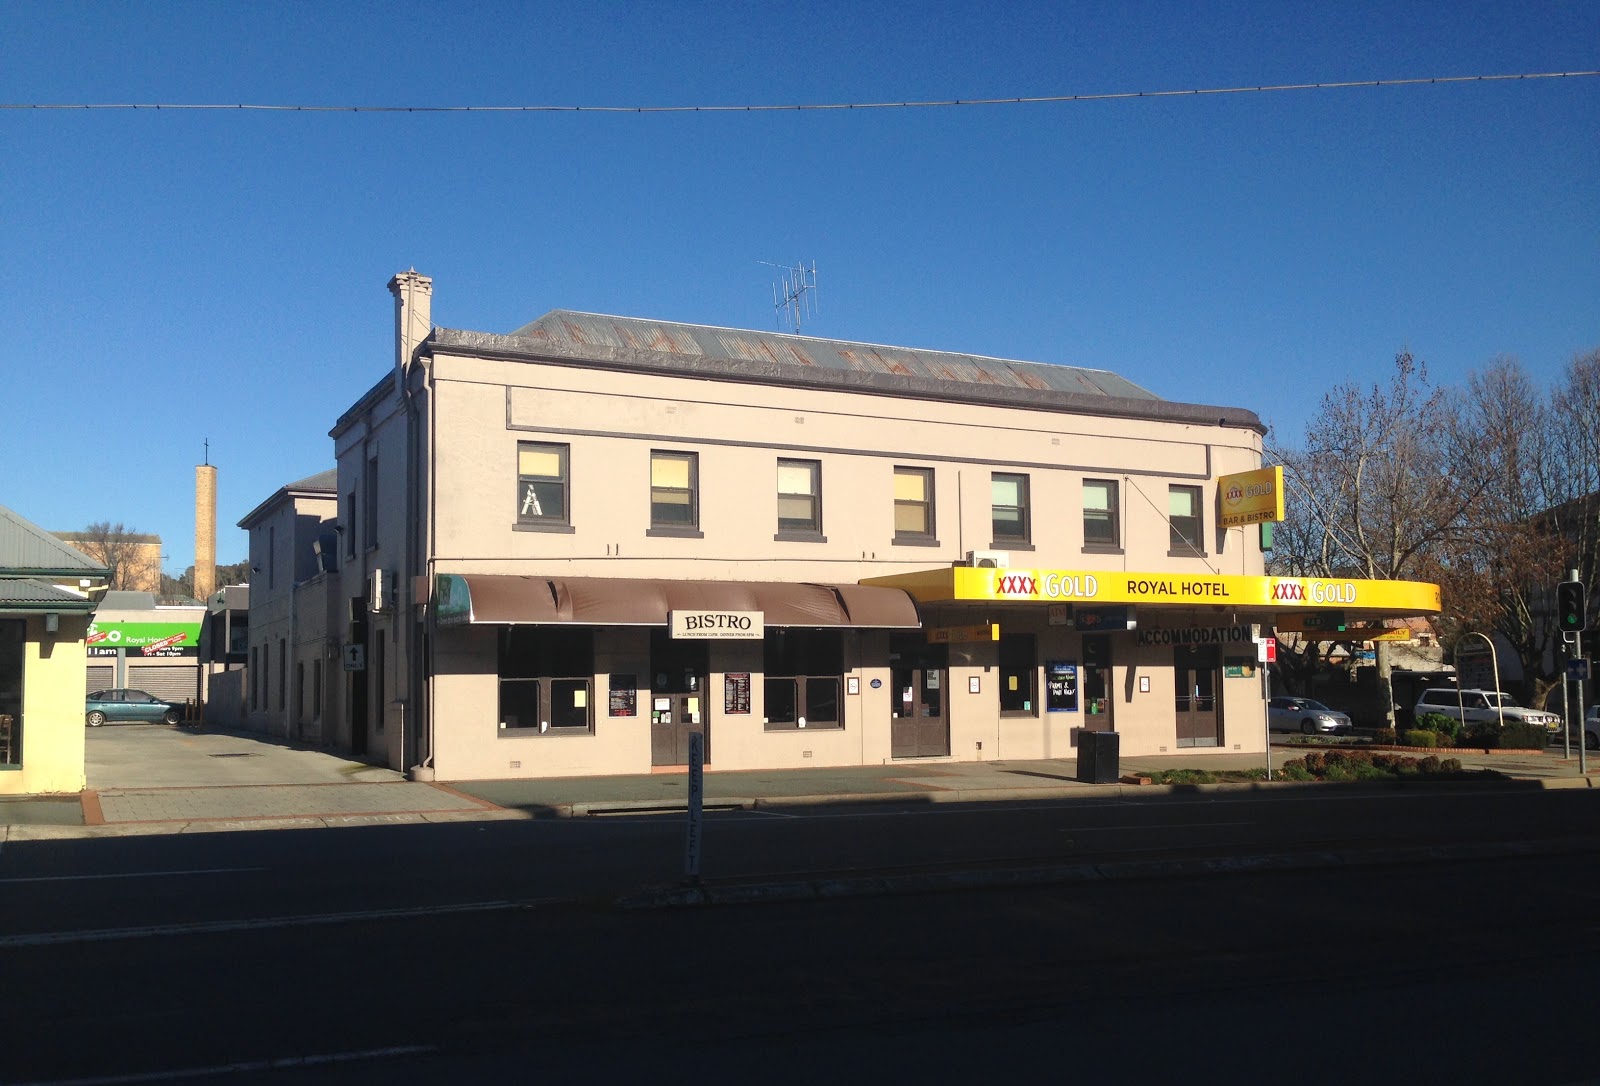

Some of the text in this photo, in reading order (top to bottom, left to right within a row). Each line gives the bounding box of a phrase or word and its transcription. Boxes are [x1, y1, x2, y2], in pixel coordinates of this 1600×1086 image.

[1245, 481, 1272, 498] GOLD
[1223, 517, 1238, 526] BAR
[1247, 510, 1275, 522] BISTRO
[996, 573, 1098, 598] XXXX GOLD
[1127, 580, 1230, 596] ROYAL HOTEL
[1271, 581, 1357, 604] XXXX GOLD
[685, 614, 752, 630] BISTRO
[126, 636, 146, 645] Royal
[1137, 625, 1250, 644] ACCOMMODATION
[144, 640, 169, 653] CLOSED
